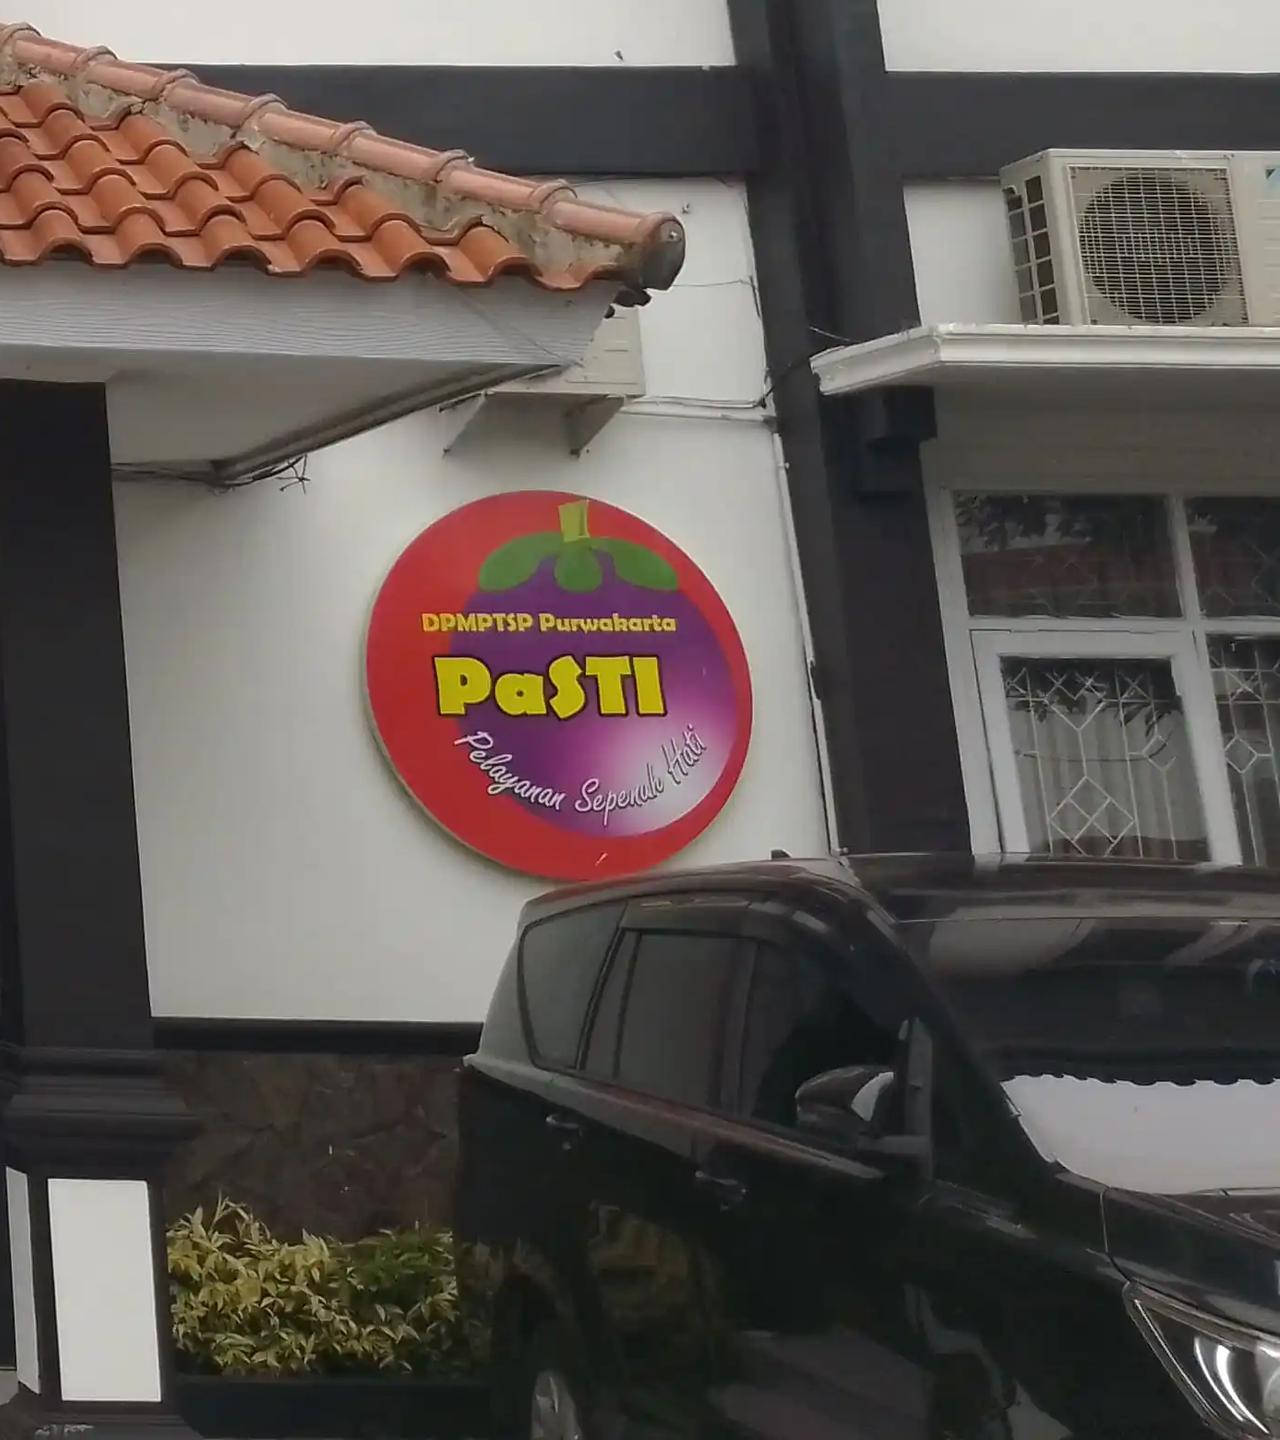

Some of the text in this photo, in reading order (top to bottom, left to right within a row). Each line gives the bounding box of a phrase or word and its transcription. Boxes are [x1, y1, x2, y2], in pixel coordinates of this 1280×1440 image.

[421, 612, 677, 634] DPMPTSP Purwakarta
[432, 654, 668, 720] PaSTI
[453, 730, 567, 811] Pelayanan
[660, 723, 707, 786] Hati
